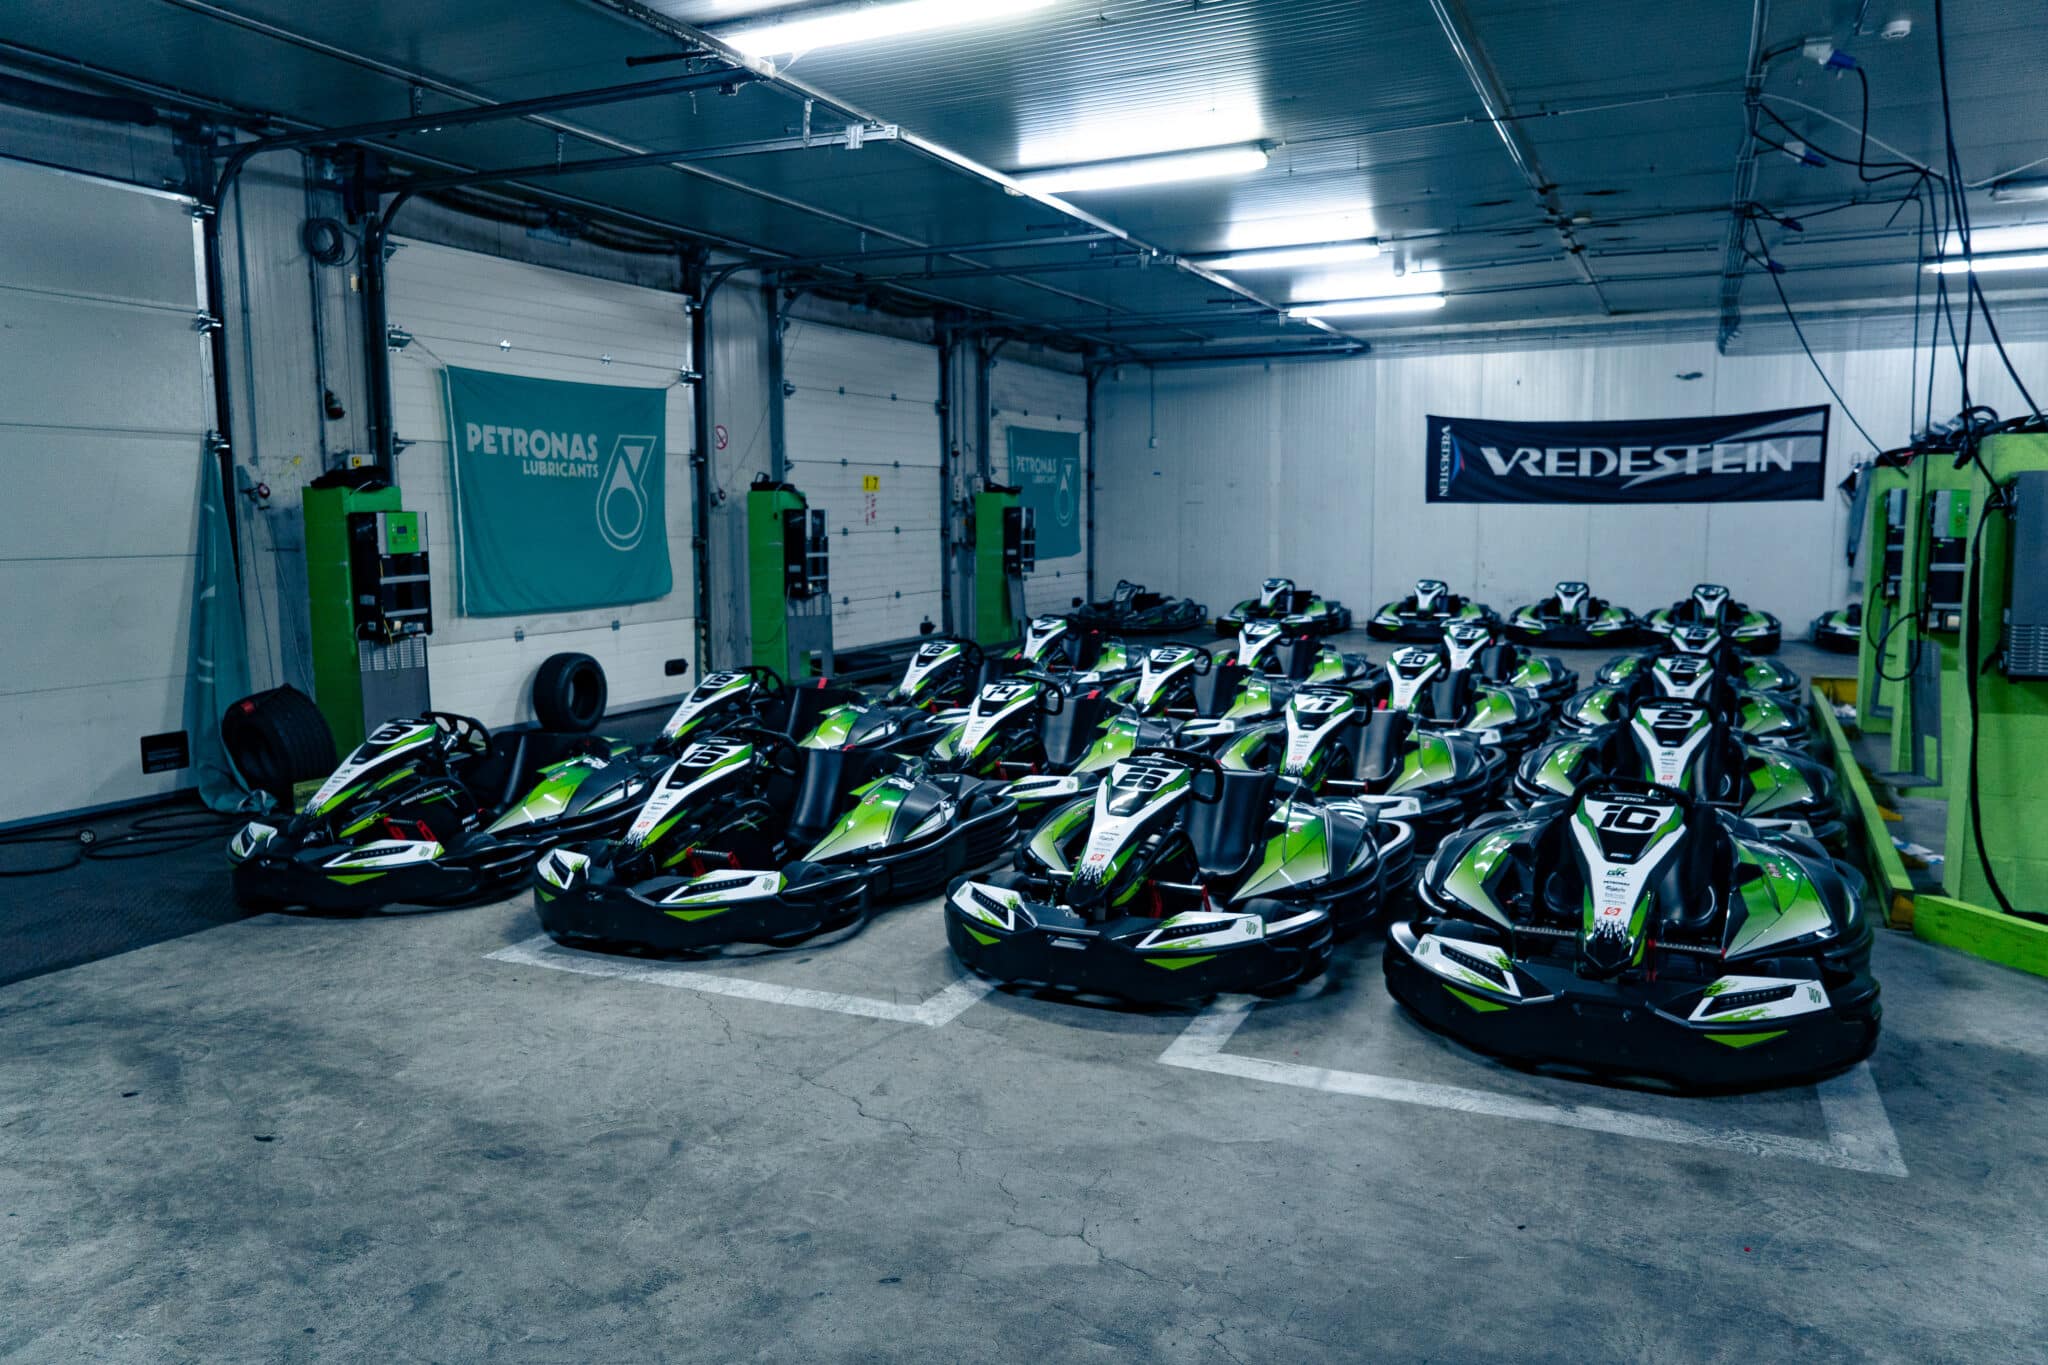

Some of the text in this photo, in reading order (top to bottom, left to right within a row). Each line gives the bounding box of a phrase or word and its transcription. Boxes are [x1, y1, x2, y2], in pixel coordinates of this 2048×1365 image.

[466, 422, 599, 462] PETRONAS
[523, 460, 599, 478] LUBRICANTS
[1439, 425, 1451, 497] VREDESTEIN
[1480, 440, 1793, 486] VREDESTEIN
[865, 476, 879, 489] 17
[1400, 652, 1428, 665] 20
[986, 686, 1021, 700] 14
[1653, 711, 1694, 726] 9
[1600, 805, 1661, 831] 10
